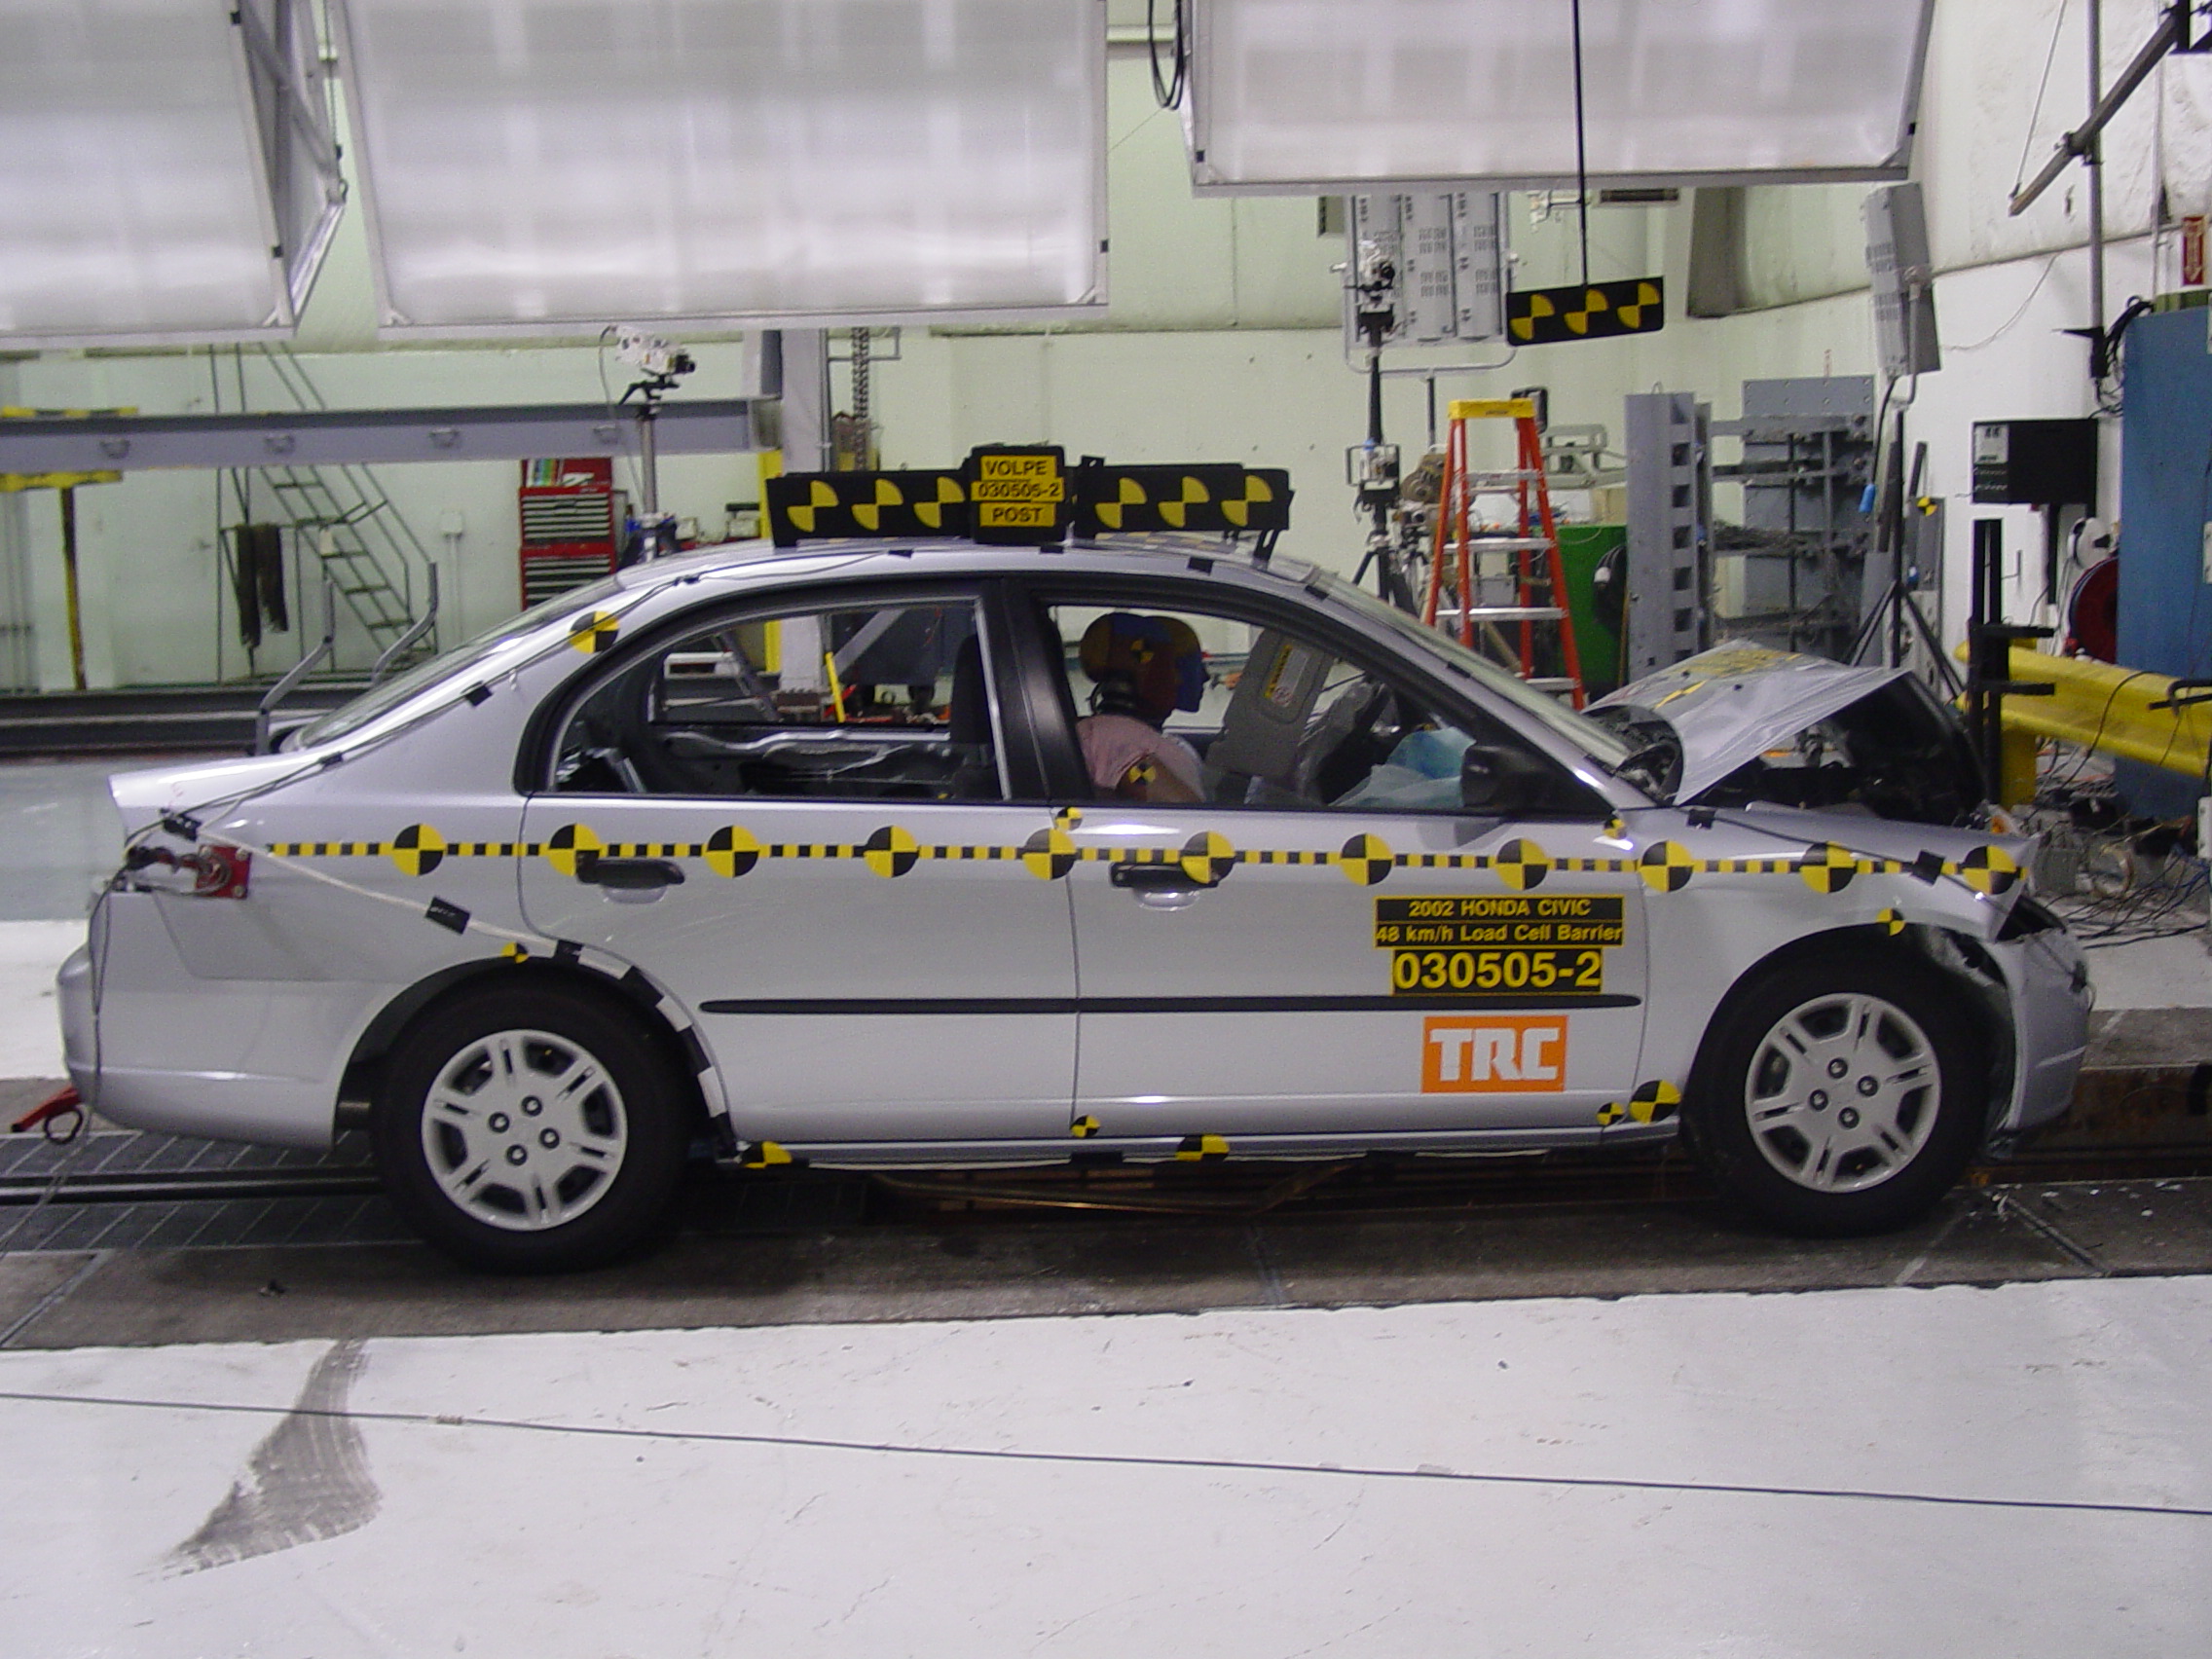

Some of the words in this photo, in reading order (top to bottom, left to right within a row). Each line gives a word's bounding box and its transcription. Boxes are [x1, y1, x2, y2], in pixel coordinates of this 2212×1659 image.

[985, 460, 1048, 476] VOLPE
[977, 482, 1061, 498] 030505-2
[992, 506, 1043, 523] POST
[1408, 900, 1455, 917] 2002
[1460, 900, 1531, 916] HONDA
[1538, 899, 1592, 916] CIVIC
[1376, 925, 1400, 942] 48
[1405, 924, 1455, 942] km/h
[1460, 924, 1508, 942] Load
[1513, 924, 1552, 941] Cell
[1557, 924, 1624, 941] Barrier
[1393, 951, 1602, 989] 030505-2
[1429, 1027, 1561, 1082] TRC
